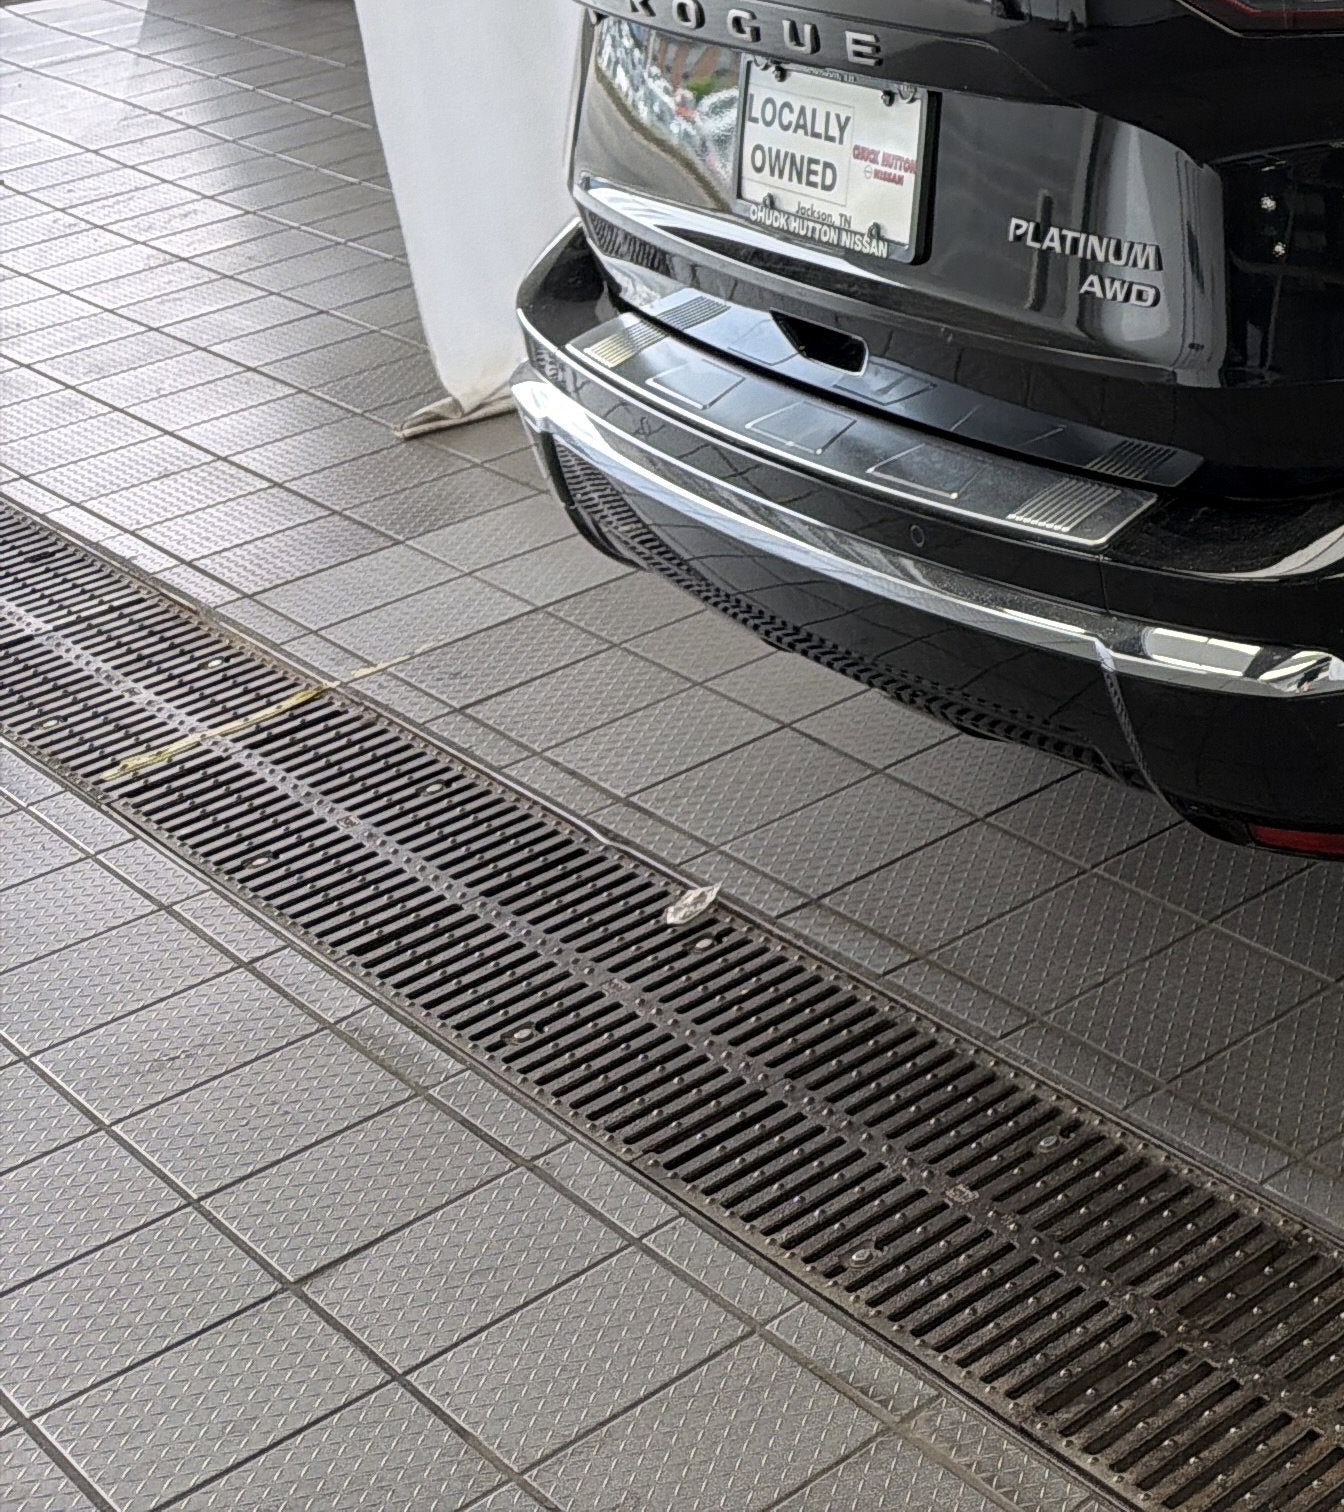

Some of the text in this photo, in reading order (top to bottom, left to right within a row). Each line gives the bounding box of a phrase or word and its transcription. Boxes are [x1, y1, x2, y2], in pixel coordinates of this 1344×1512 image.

[747, 93, 851, 145] LOCALLY
[751, 143, 838, 192] OWNED
[749, 204, 888, 258] CHUCK HUTTON NISSAN
[795, 201, 852, 229] Jackson, TN
[1008, 217, 1160, 271] PLATINUM
[1079, 273, 1160, 308] AWD
